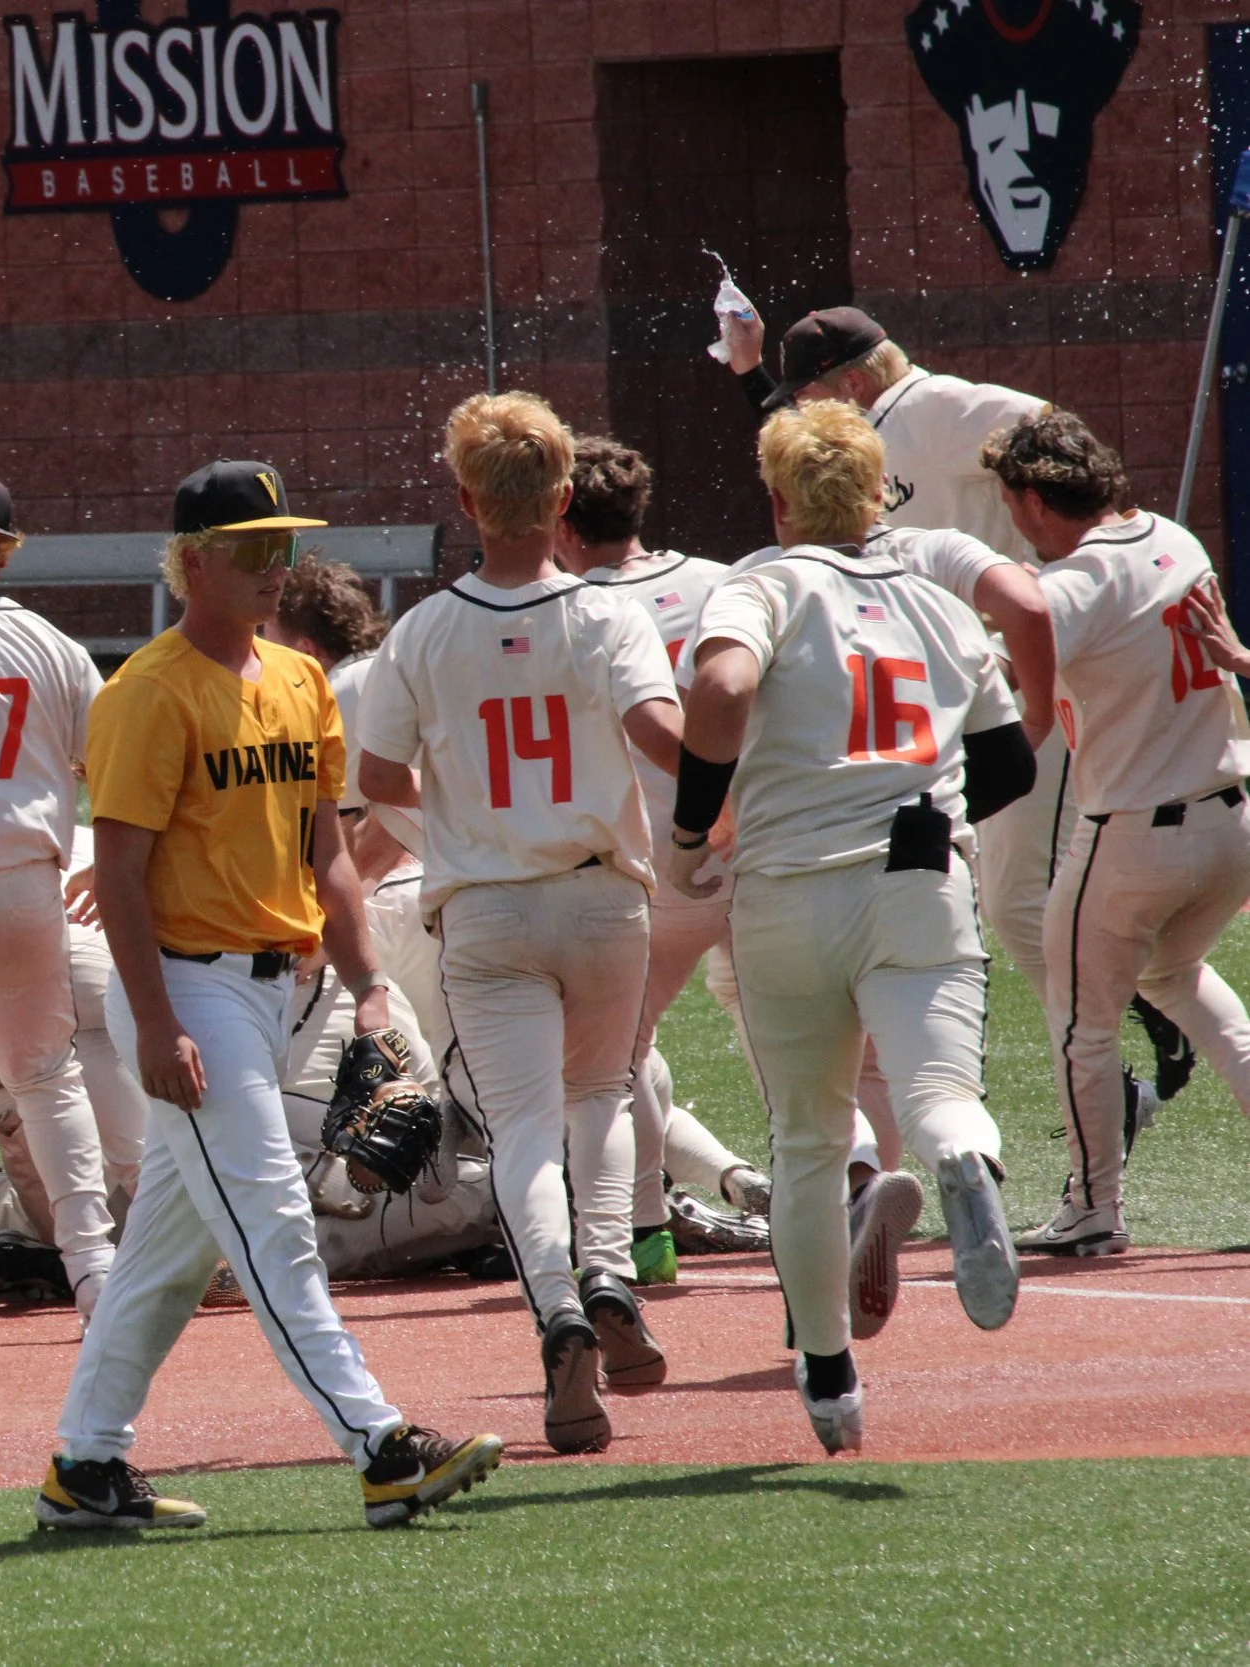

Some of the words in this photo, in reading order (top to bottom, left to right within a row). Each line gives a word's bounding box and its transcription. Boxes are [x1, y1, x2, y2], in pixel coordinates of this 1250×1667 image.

[10, 20, 333, 147] MISSION
[42, 158, 302, 198] BASEBALL
[255, 472, 278, 506] V
[478, 695, 572, 809] 14
[846, 655, 938, 765] 16
